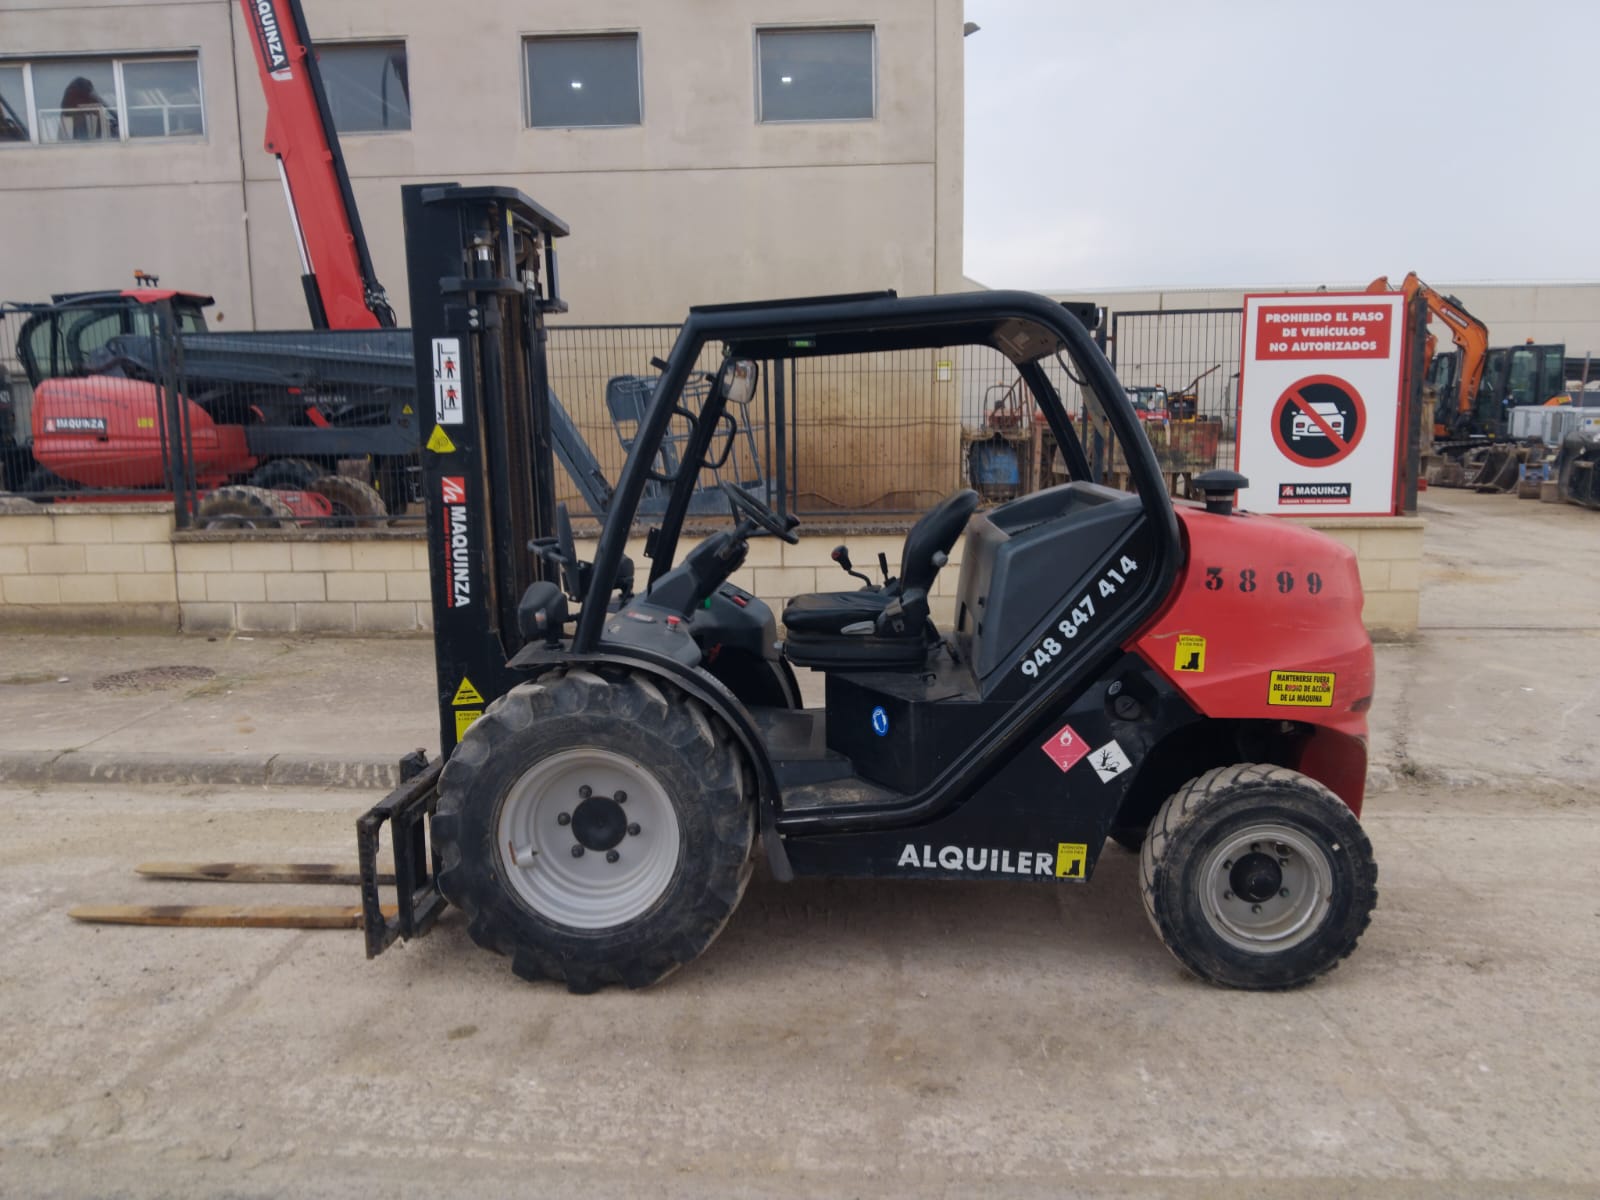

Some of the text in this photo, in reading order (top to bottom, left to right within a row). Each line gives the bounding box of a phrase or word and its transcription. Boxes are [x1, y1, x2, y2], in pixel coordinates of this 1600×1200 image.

[256, 0, 285, 66] QUINZA
[1265, 312, 1384, 323] PROHIBIDO EL PASO
[1282, 325, 1366, 337] DE VEHÍCULOS
[1269, 341, 1377, 352] NO AUTORIZADOS
[1296, 486, 1348, 495] MAQUINZA
[451, 506, 471, 607] MAQUINZA
[1021, 555, 1138, 678] 948 847 414
[1276, 674, 1330, 683] MANTENERSE FUERA
[1280, 693, 1287, 701] DE
[897, 844, 1053, 876] ALQUILER
